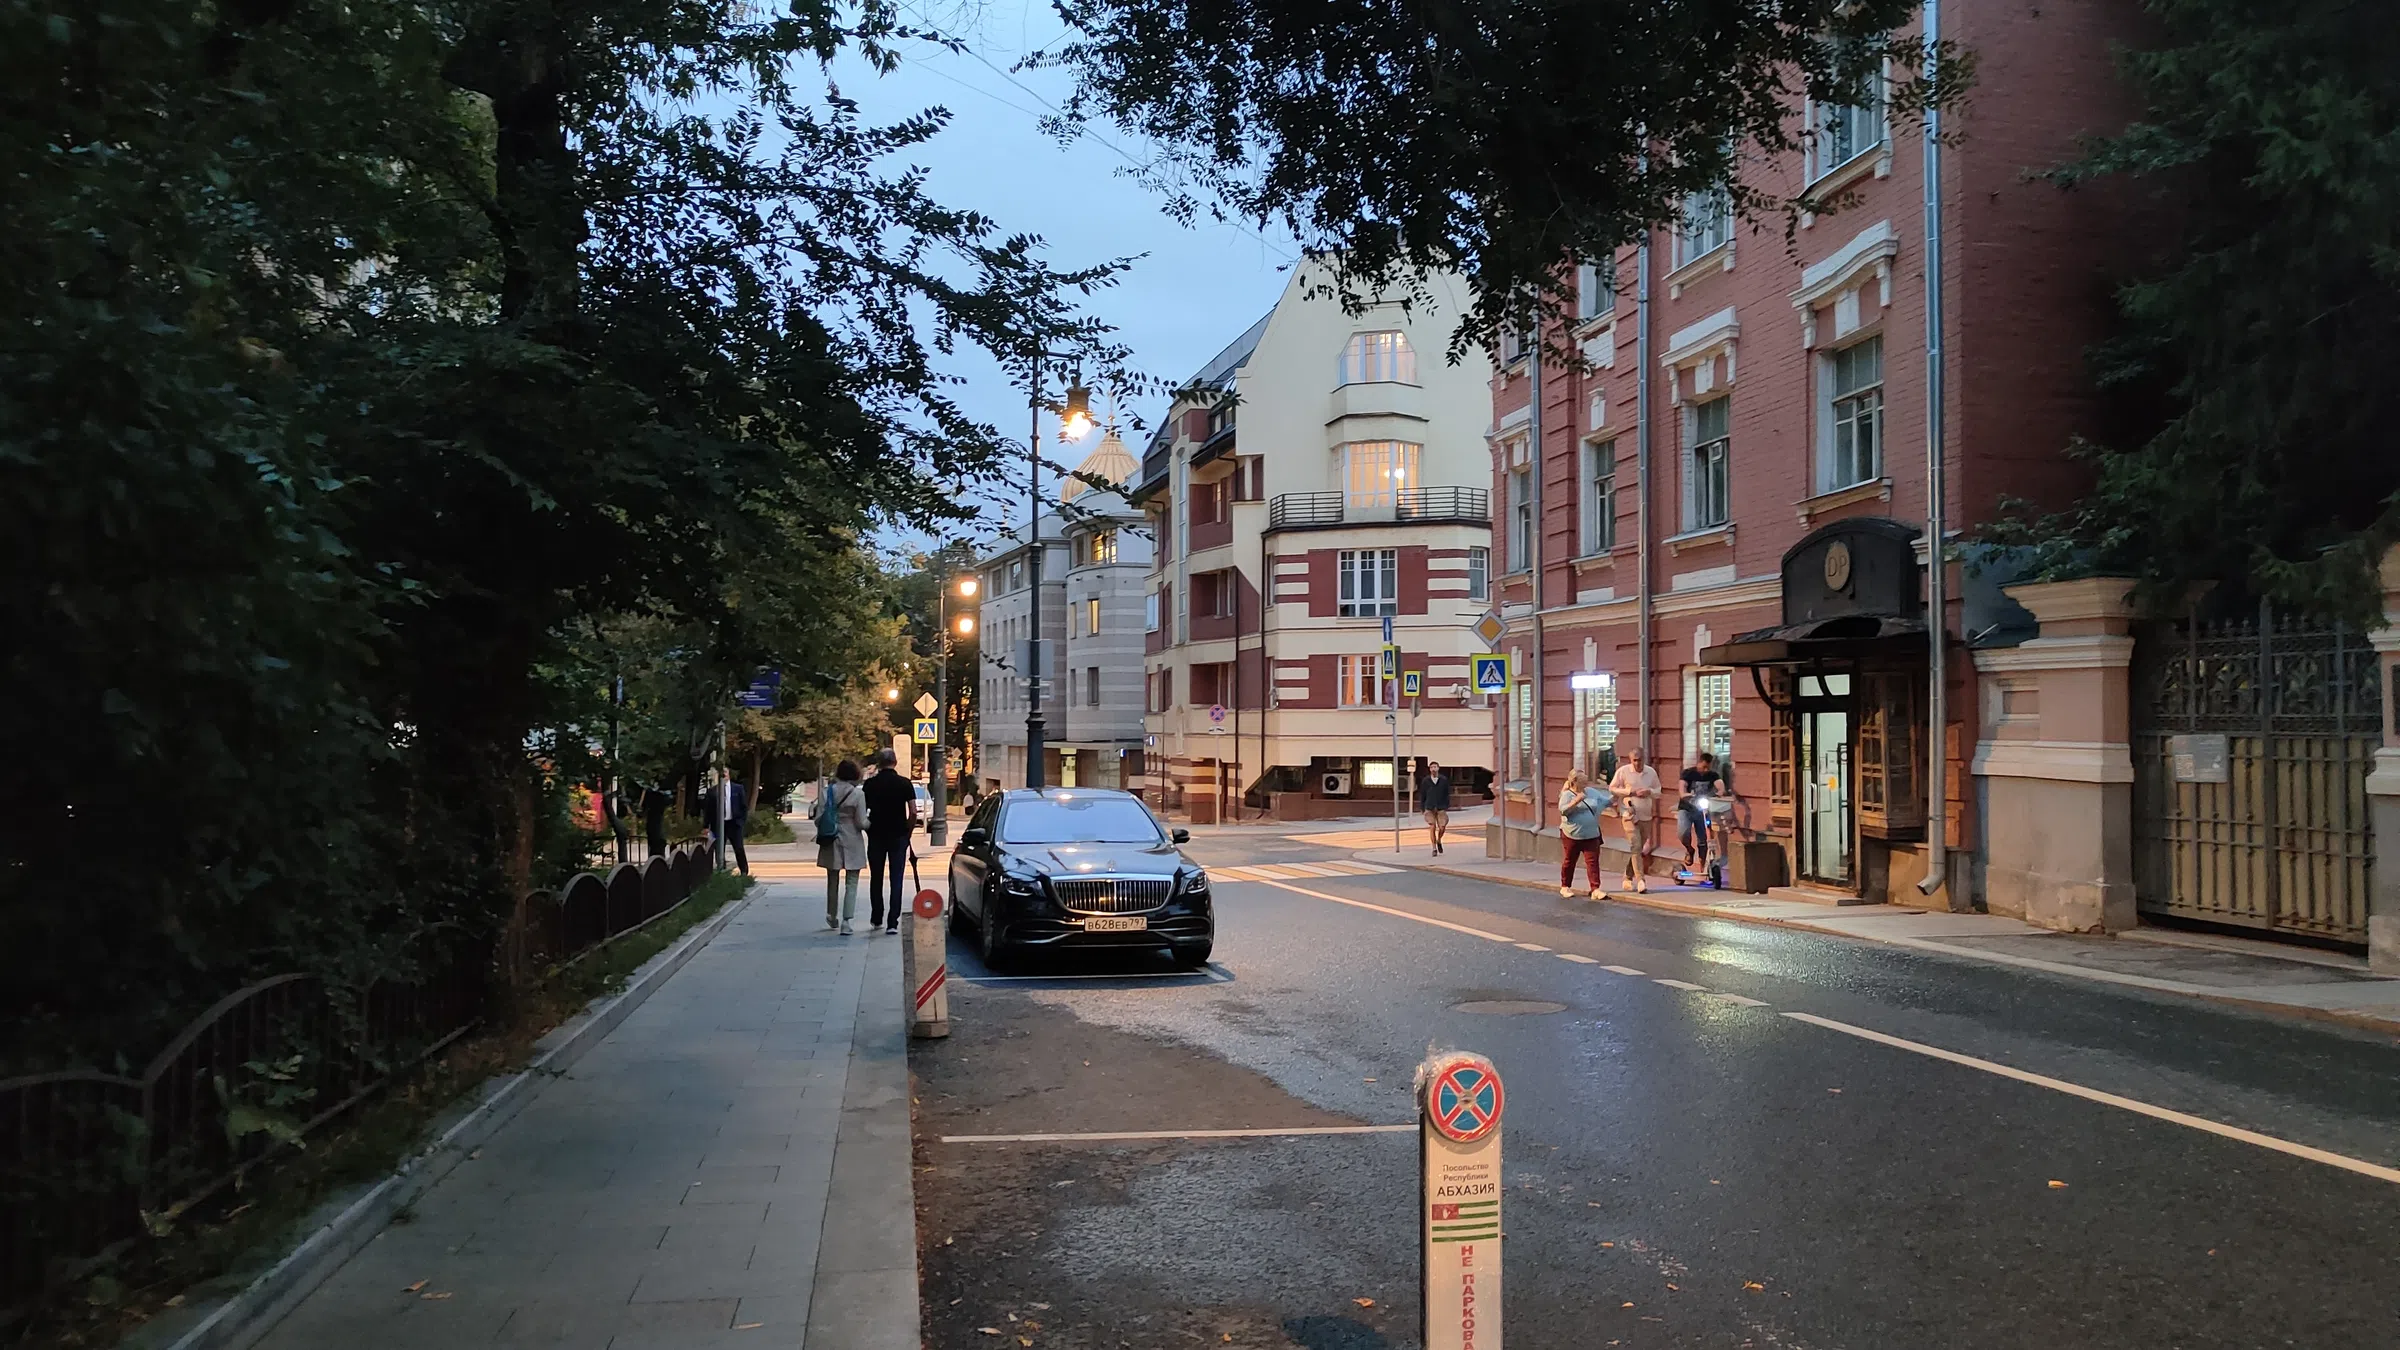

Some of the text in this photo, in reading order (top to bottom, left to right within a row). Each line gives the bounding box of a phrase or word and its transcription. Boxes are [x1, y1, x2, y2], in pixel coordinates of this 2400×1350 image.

[1828, 555, 1847, 577] DP
[1443, 1164, 1489, 1172] Посольство
[1443, 1174, 1489, 1182] Республики
[1437, 1183, 1495, 1197] АБХАЗИЯ
[1461, 1245, 1474, 1267] НЕ
